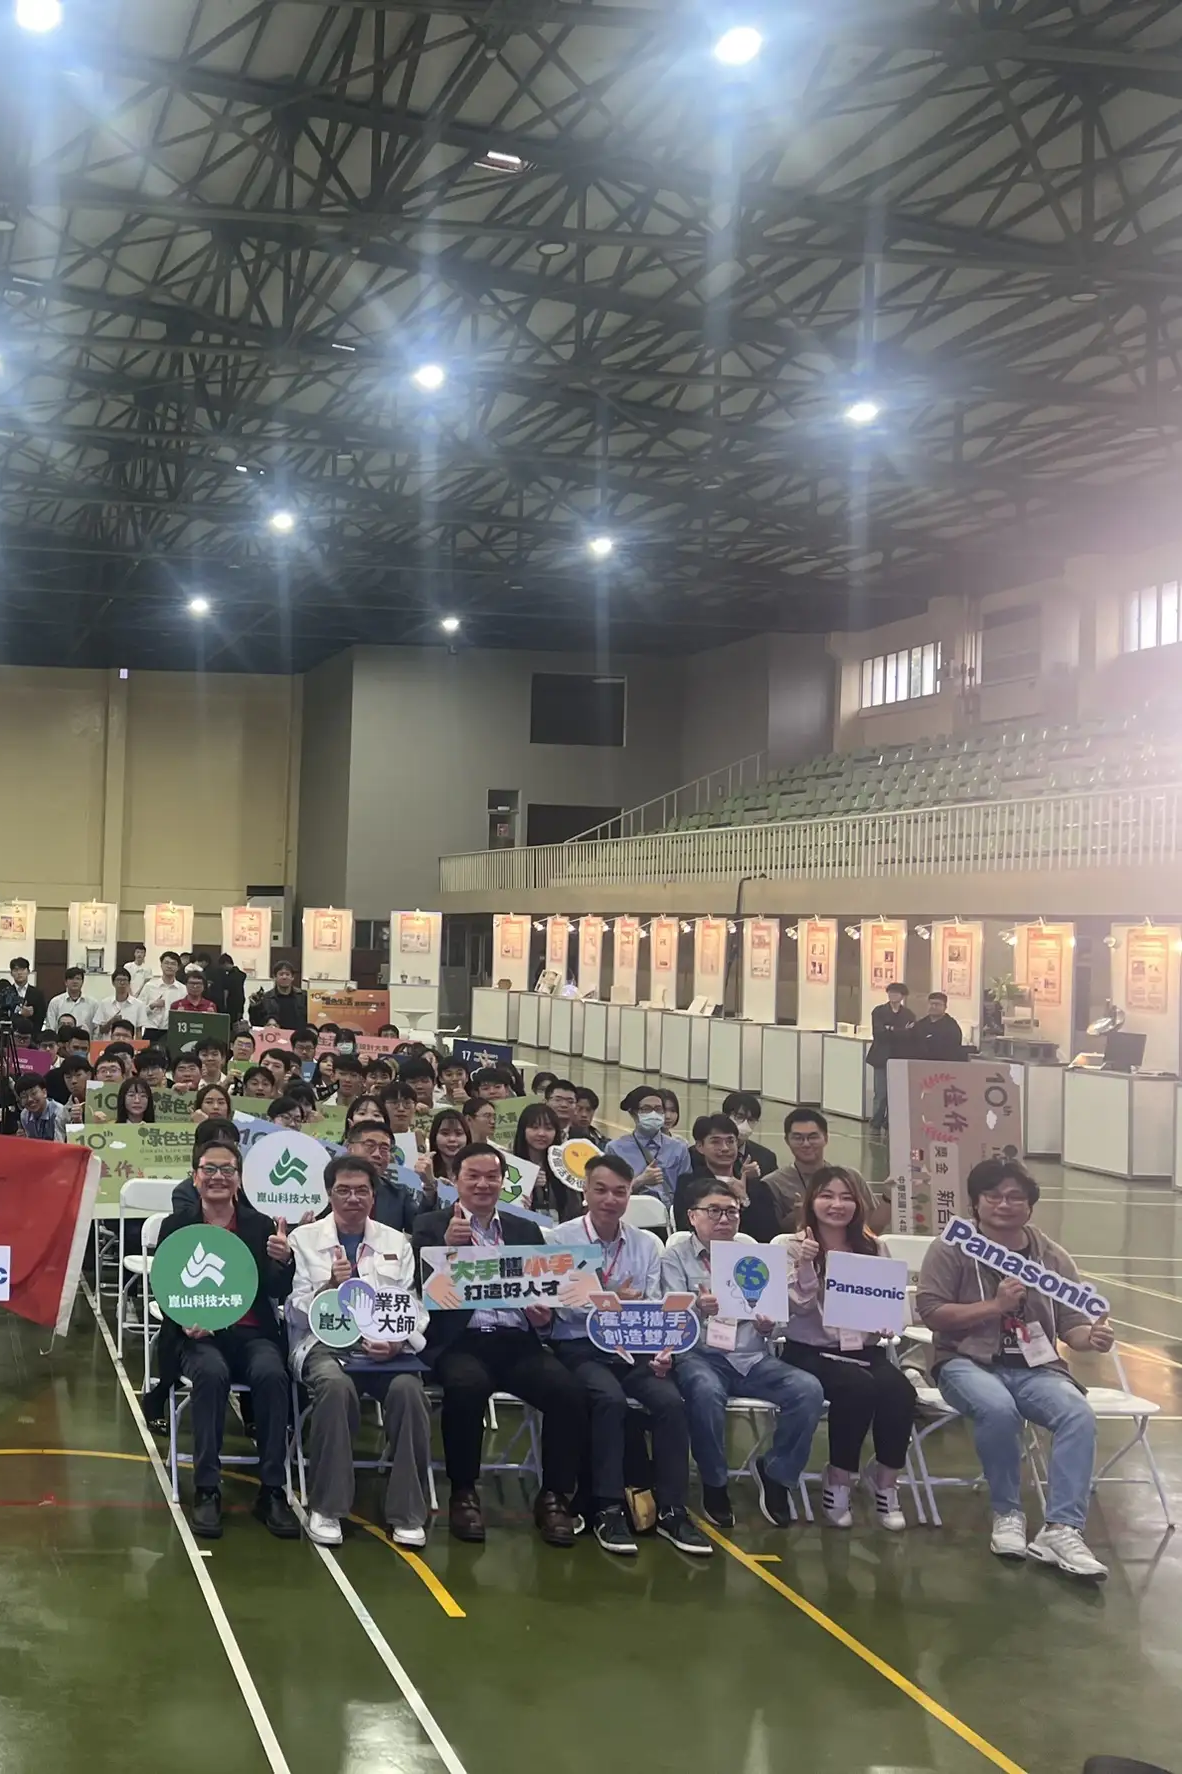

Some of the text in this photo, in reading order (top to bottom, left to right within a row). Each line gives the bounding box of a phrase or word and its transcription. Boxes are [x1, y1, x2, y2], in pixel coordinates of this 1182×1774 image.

[177, 1022, 188, 1033] 13
[461, 1050, 471, 1061] 17
[984, 1072, 1013, 1117] 10th
[943, 1085, 969, 1133] 佳作
[75, 1130, 114, 1150] 10th
[256, 1191, 322, 1205] 崑山科技大學
[936, 1190, 955, 1235] 新台
[944, 1218, 1108, 1317] Panasonic
[463, 1280, 560, 1301] 打造好人才
[825, 1278, 905, 1301] Panasonic
[168, 1293, 243, 1309] 崑山科技大學
[375, 1292, 412, 1314] 業界
[318, 1312, 352, 1331] 崑大
[378, 1314, 416, 1335] 大師
[603, 1329, 685, 1346] 創造雙贏
